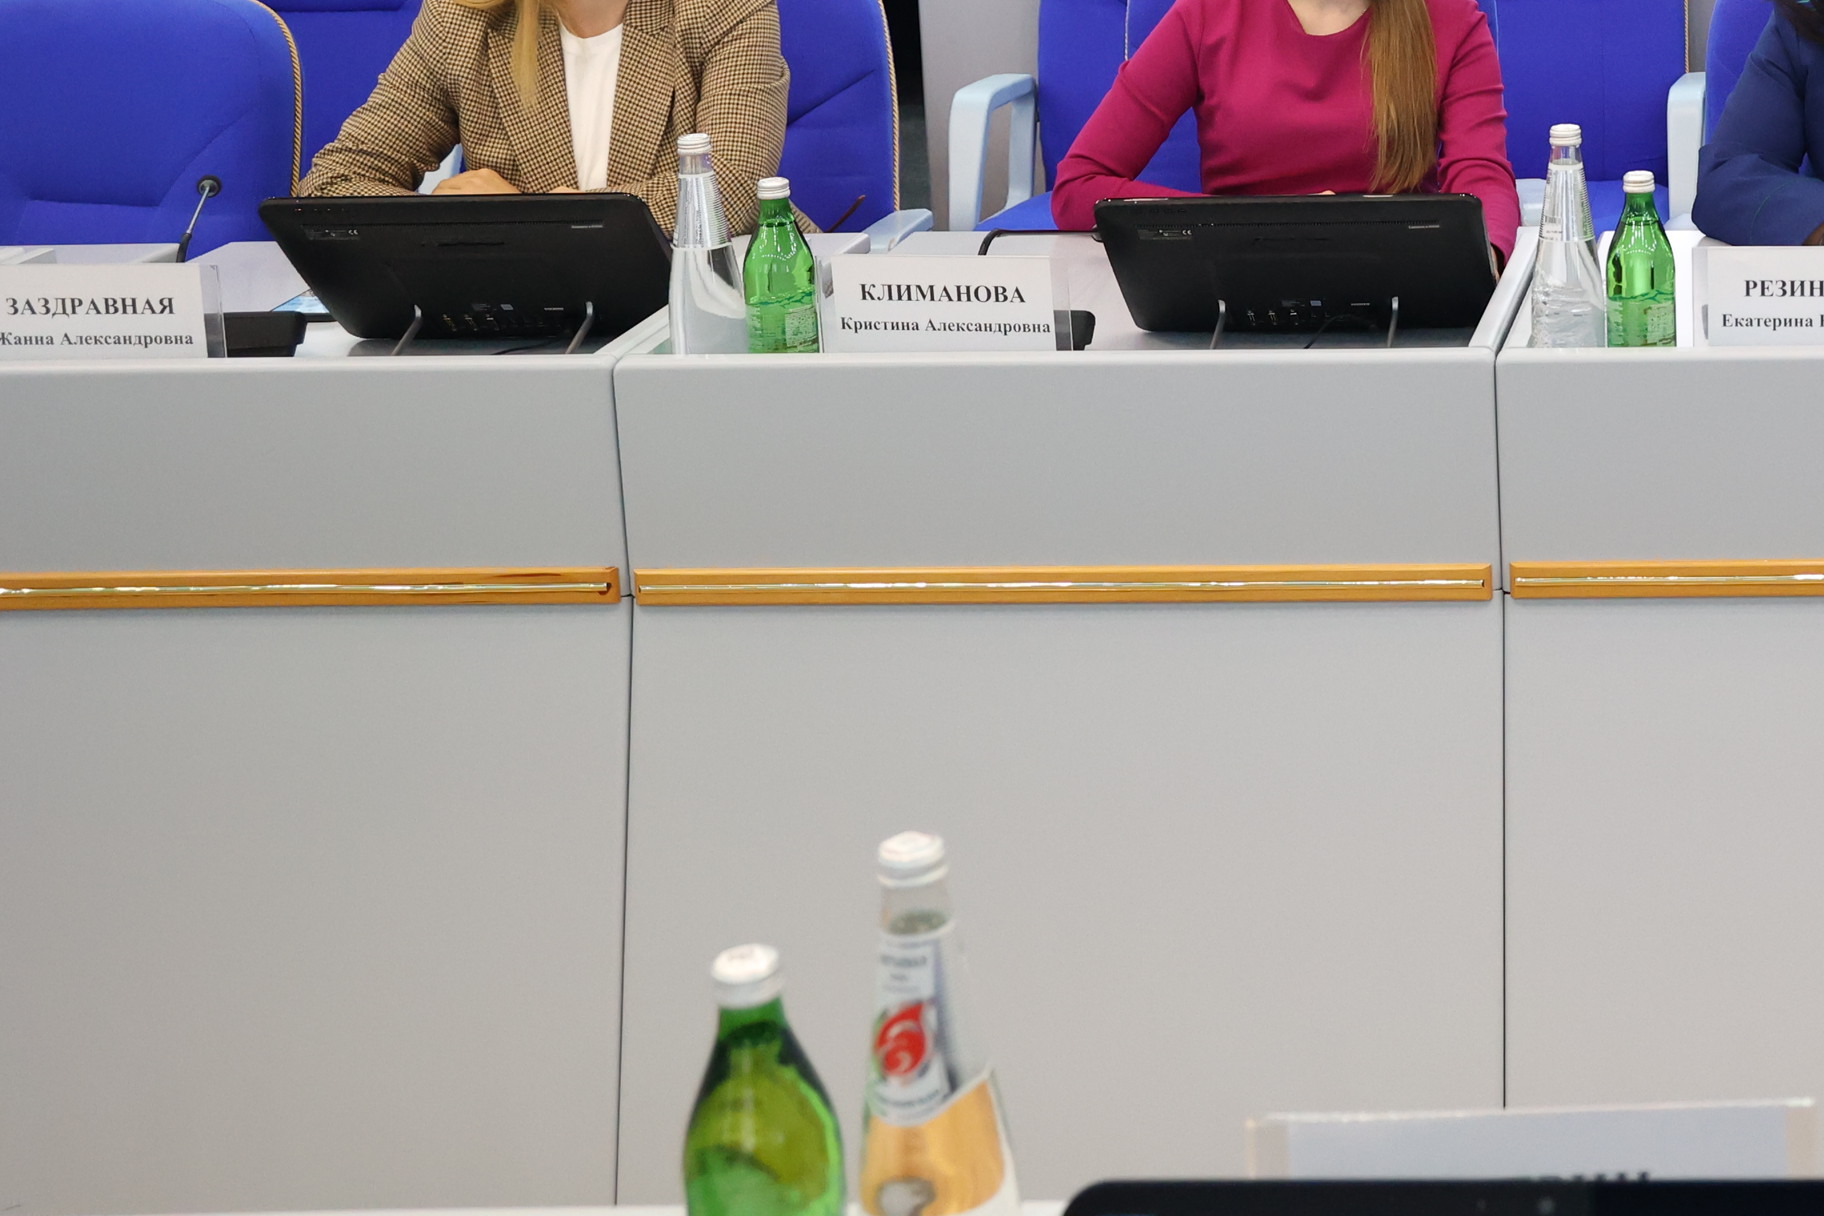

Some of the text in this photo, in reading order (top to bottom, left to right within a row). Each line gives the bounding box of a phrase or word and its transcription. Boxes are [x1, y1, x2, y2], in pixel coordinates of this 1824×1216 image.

[859, 283, 1026, 304] КЛИМАНОВА
[5, 297, 175, 319] ЗАЗДРАВНАЯ
[840, 316, 920, 334] Кристина
[925, 318, 1051, 337] Александровна
[1722, 313, 1814, 332] Екатерина
[60, 332, 194, 349] Александровна
